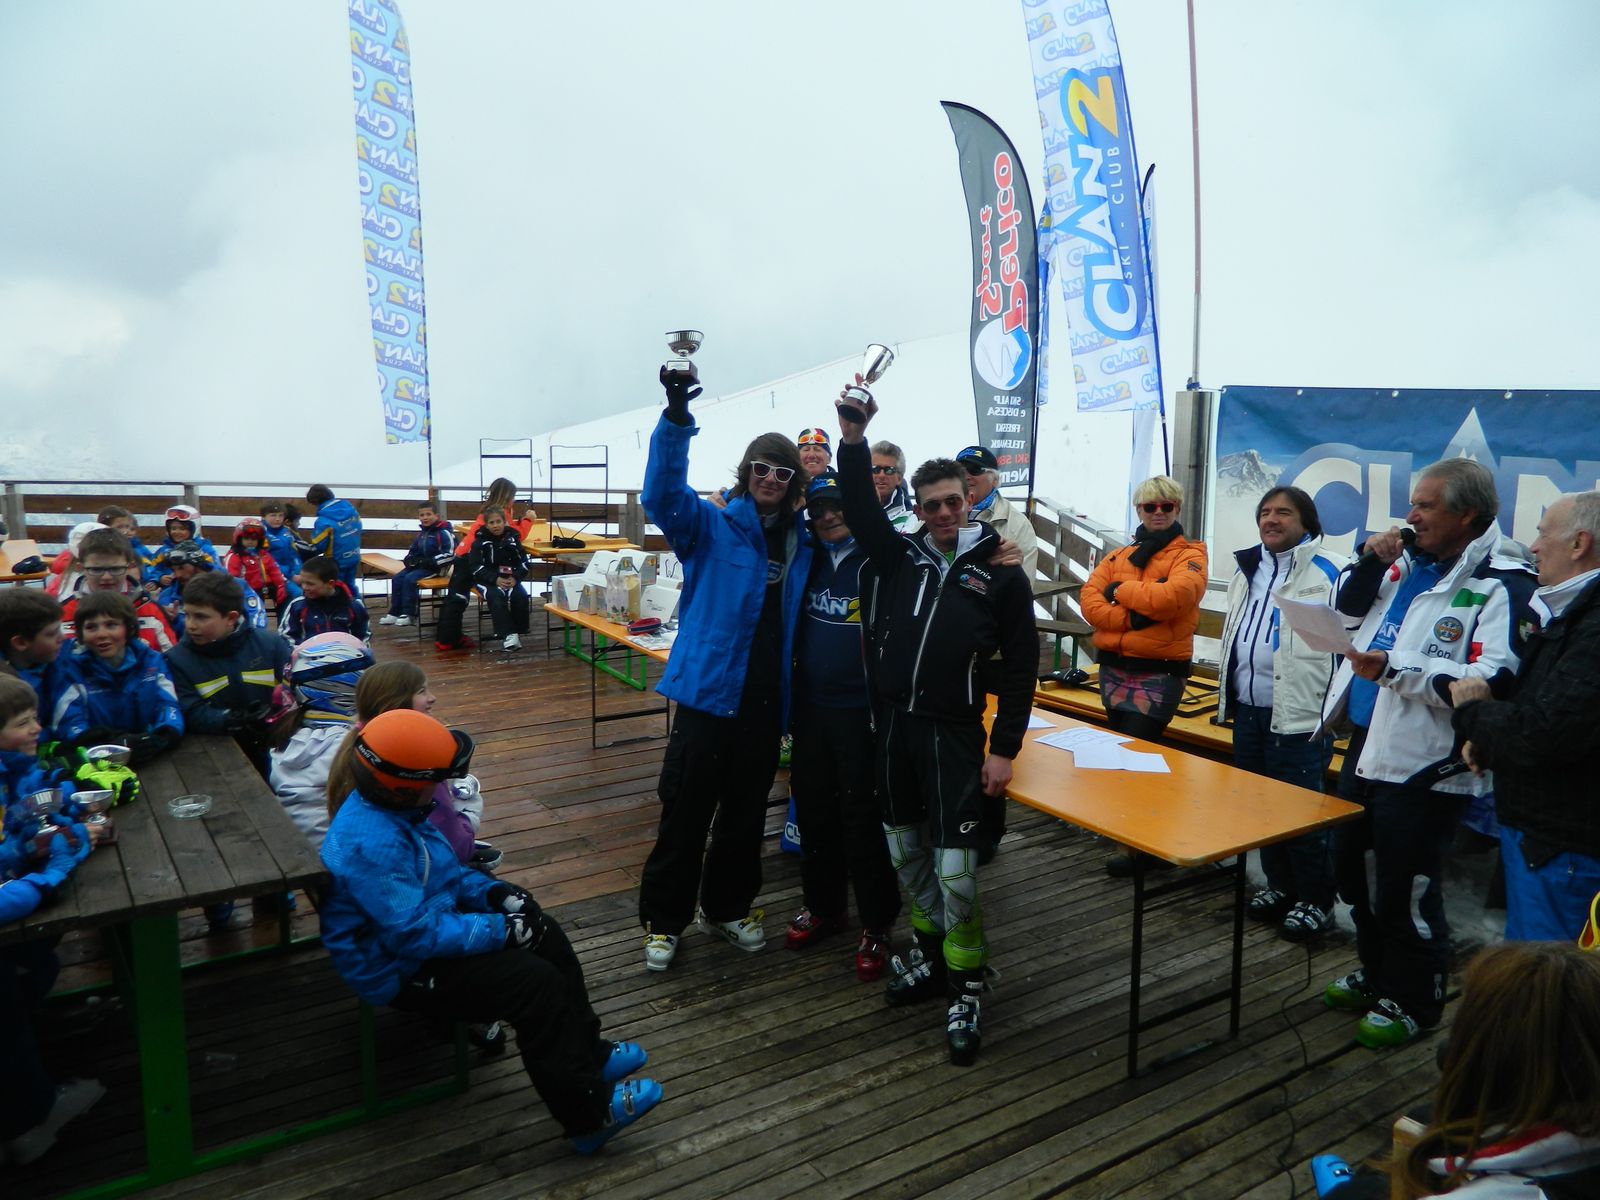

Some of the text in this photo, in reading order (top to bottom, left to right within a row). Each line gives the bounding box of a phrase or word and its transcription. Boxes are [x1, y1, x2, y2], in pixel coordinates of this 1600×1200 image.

[1043, 34, 1095, 59] CLAN2
[1107, 147, 1124, 204] CLUB
[1068, 76, 1138, 332] CLAN2
[1119, 246, 1133, 280] SKI
[1101, 347, 1149, 373] CLAN2
